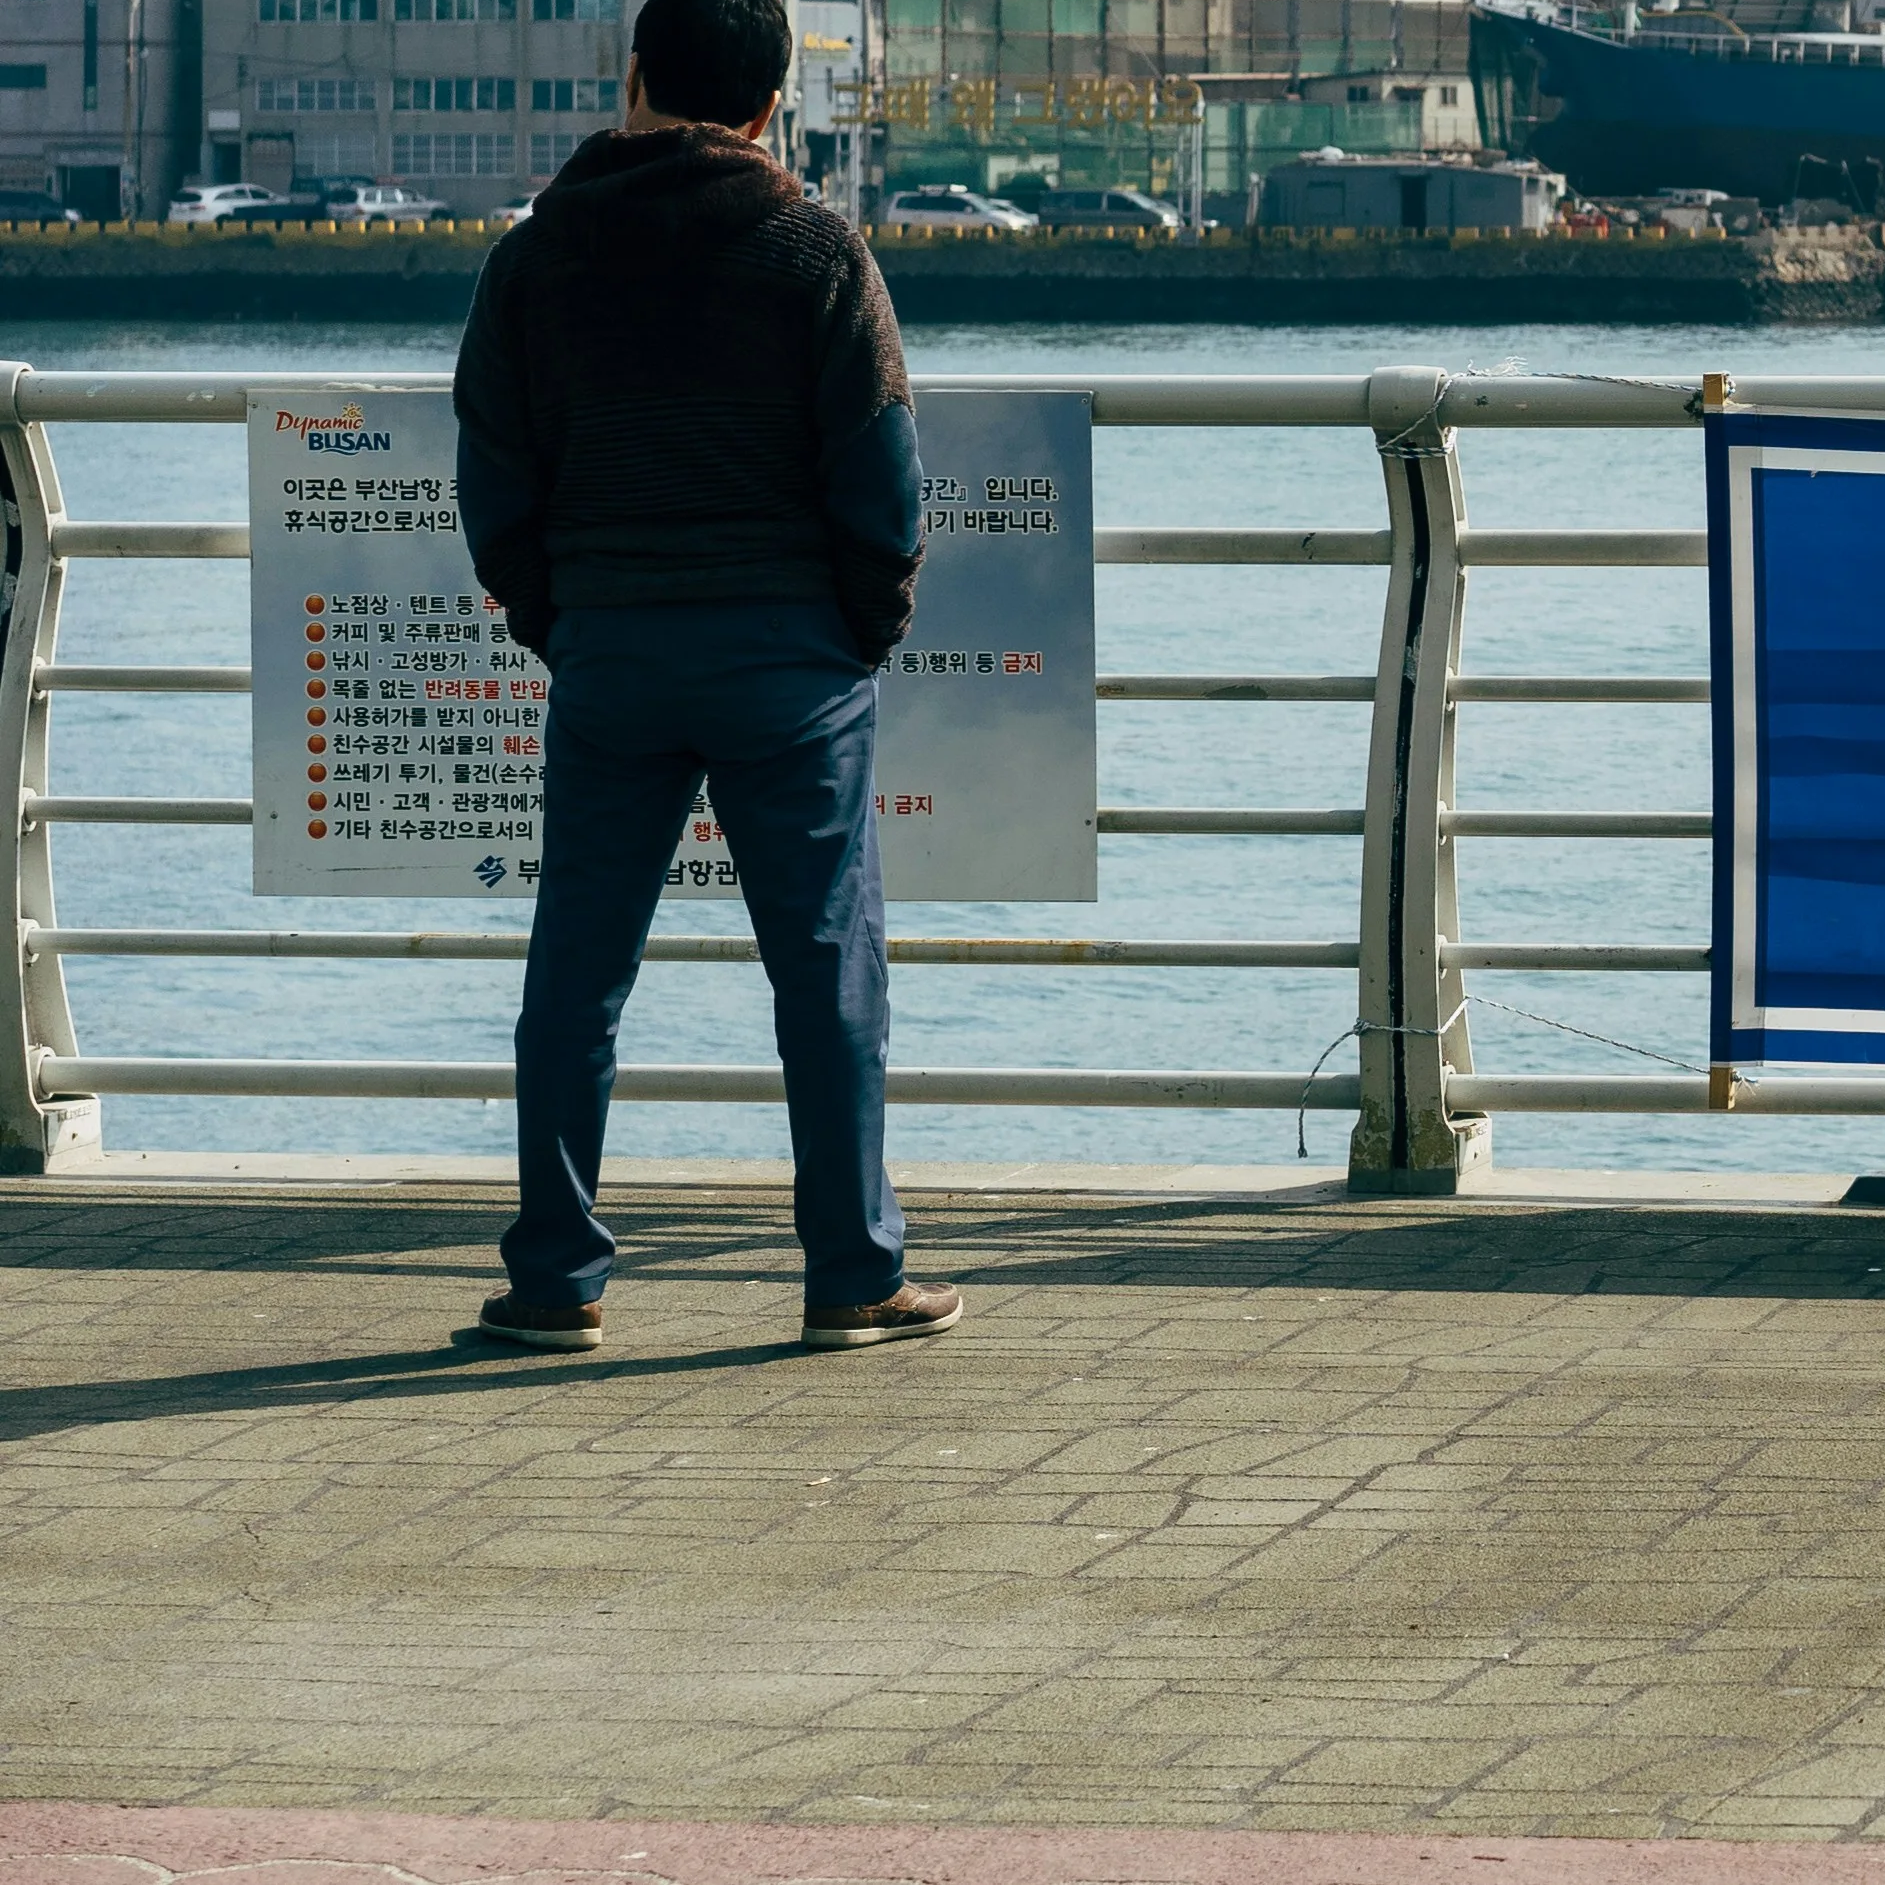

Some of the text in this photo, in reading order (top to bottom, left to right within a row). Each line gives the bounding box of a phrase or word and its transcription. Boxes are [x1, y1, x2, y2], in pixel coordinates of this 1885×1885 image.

[830, 78, 1204, 132] 그때 왜 그랬어요
[275, 411, 364, 440] Dynamic
[308, 432, 391, 451] BUSAN
[283, 478, 347, 501] 이곳은
[355, 478, 442, 502] 부산남항
[985, 478, 1059, 501] 입니다.
[284, 510, 457, 533] 휴식공간으로서의
[964, 511, 1059, 534] 바랍니다.
[331, 595, 389, 616] 노점상
[410, 595, 448, 615] 텐트
[455, 595, 475, 615] 등
[331, 622, 369, 643] 커피
[378, 622, 397, 643] 및
[405, 622, 481, 643] 주류판매
[331, 651, 370, 672] 낚시
[390, 651, 468, 672] 고성방가
[489, 651, 527, 672] 취사
[901, 652, 967, 674] 등)행위
[975, 653, 995, 674] 등
[1003, 652, 1042, 674] 금지
[331, 679, 547, 700] 목줄 없는 반려동물 반입
[332, 707, 540, 727] 사용허가를 받지 아니한
[333, 734, 541, 756] 친수공간 시설물의 훼손
[333, 763, 390, 783] 쓰레기
[398, 763, 443, 785] 투기,
[333, 792, 371, 812] 시민
[392, 792, 430, 812] 고객
[894, 794, 933, 815] 금지
[334, 820, 372, 840] 기타
[379, 820, 533, 841] 친수공간으로서의
